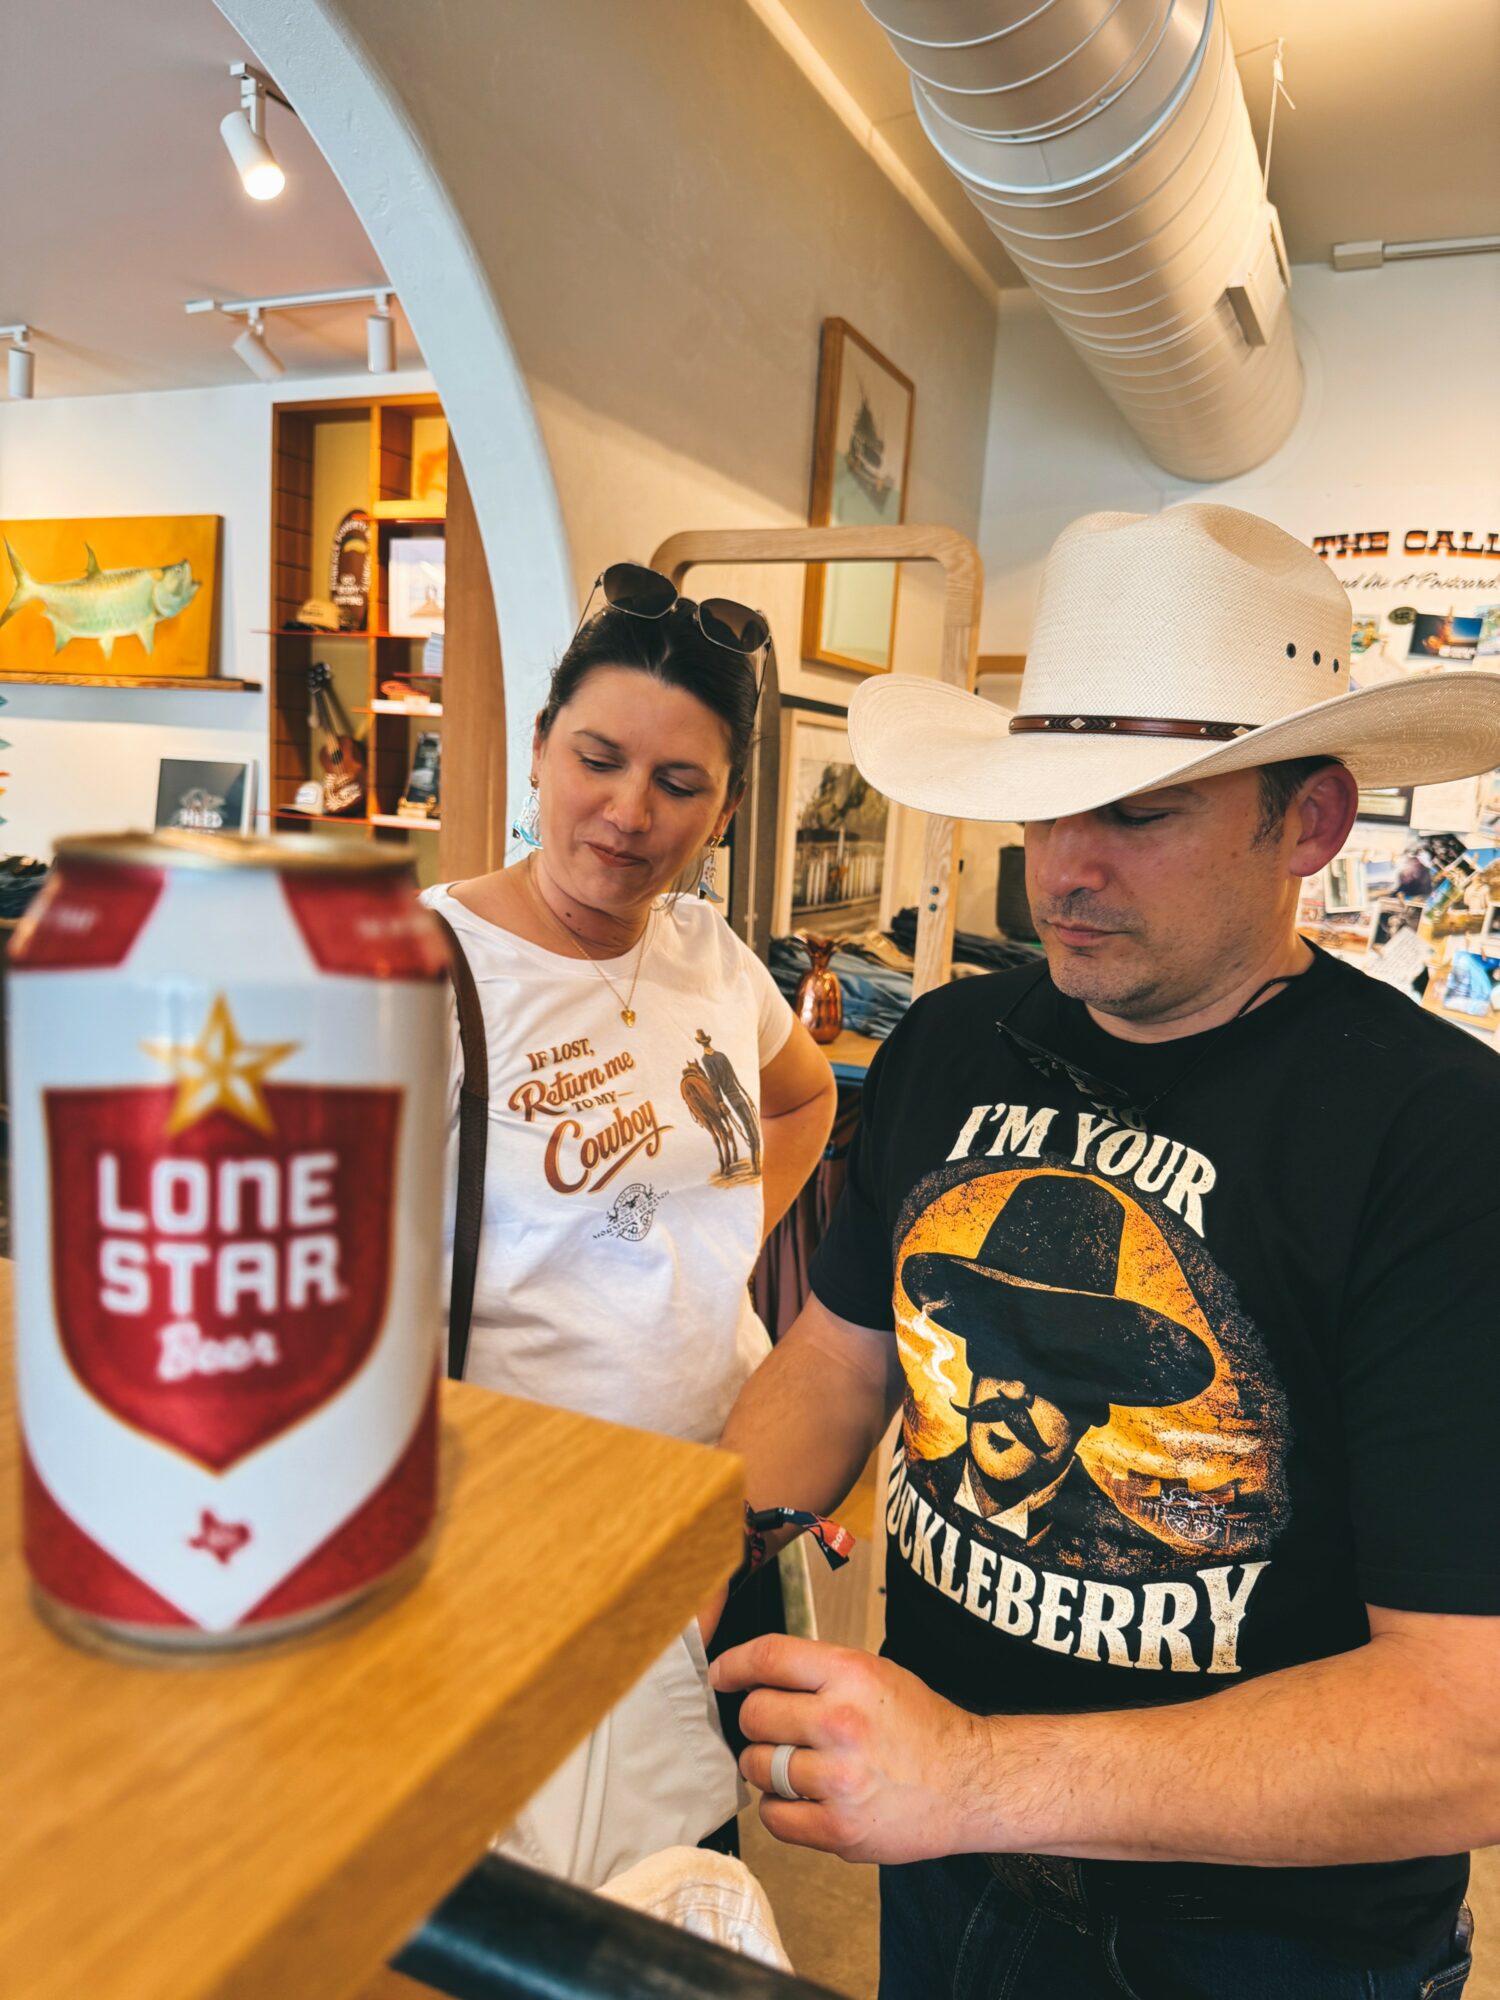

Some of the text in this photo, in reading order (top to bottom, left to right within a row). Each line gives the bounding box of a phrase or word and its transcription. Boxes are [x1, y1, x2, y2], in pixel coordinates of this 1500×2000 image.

[1312, 531, 1389, 560] THE
[508, 1051, 635, 1121] Return me
[527, 1038, 594, 1072] IF LOST,
[572, 1091, 617, 1113] TO MY
[544, 1100, 674, 1194] Cowboy
[946, 1103, 1217, 1238] I'M YOUR
[98, 1152, 337, 1235] LONE
[99, 1234, 341, 1316] STAR
[156, 1319, 278, 1382] Beer
